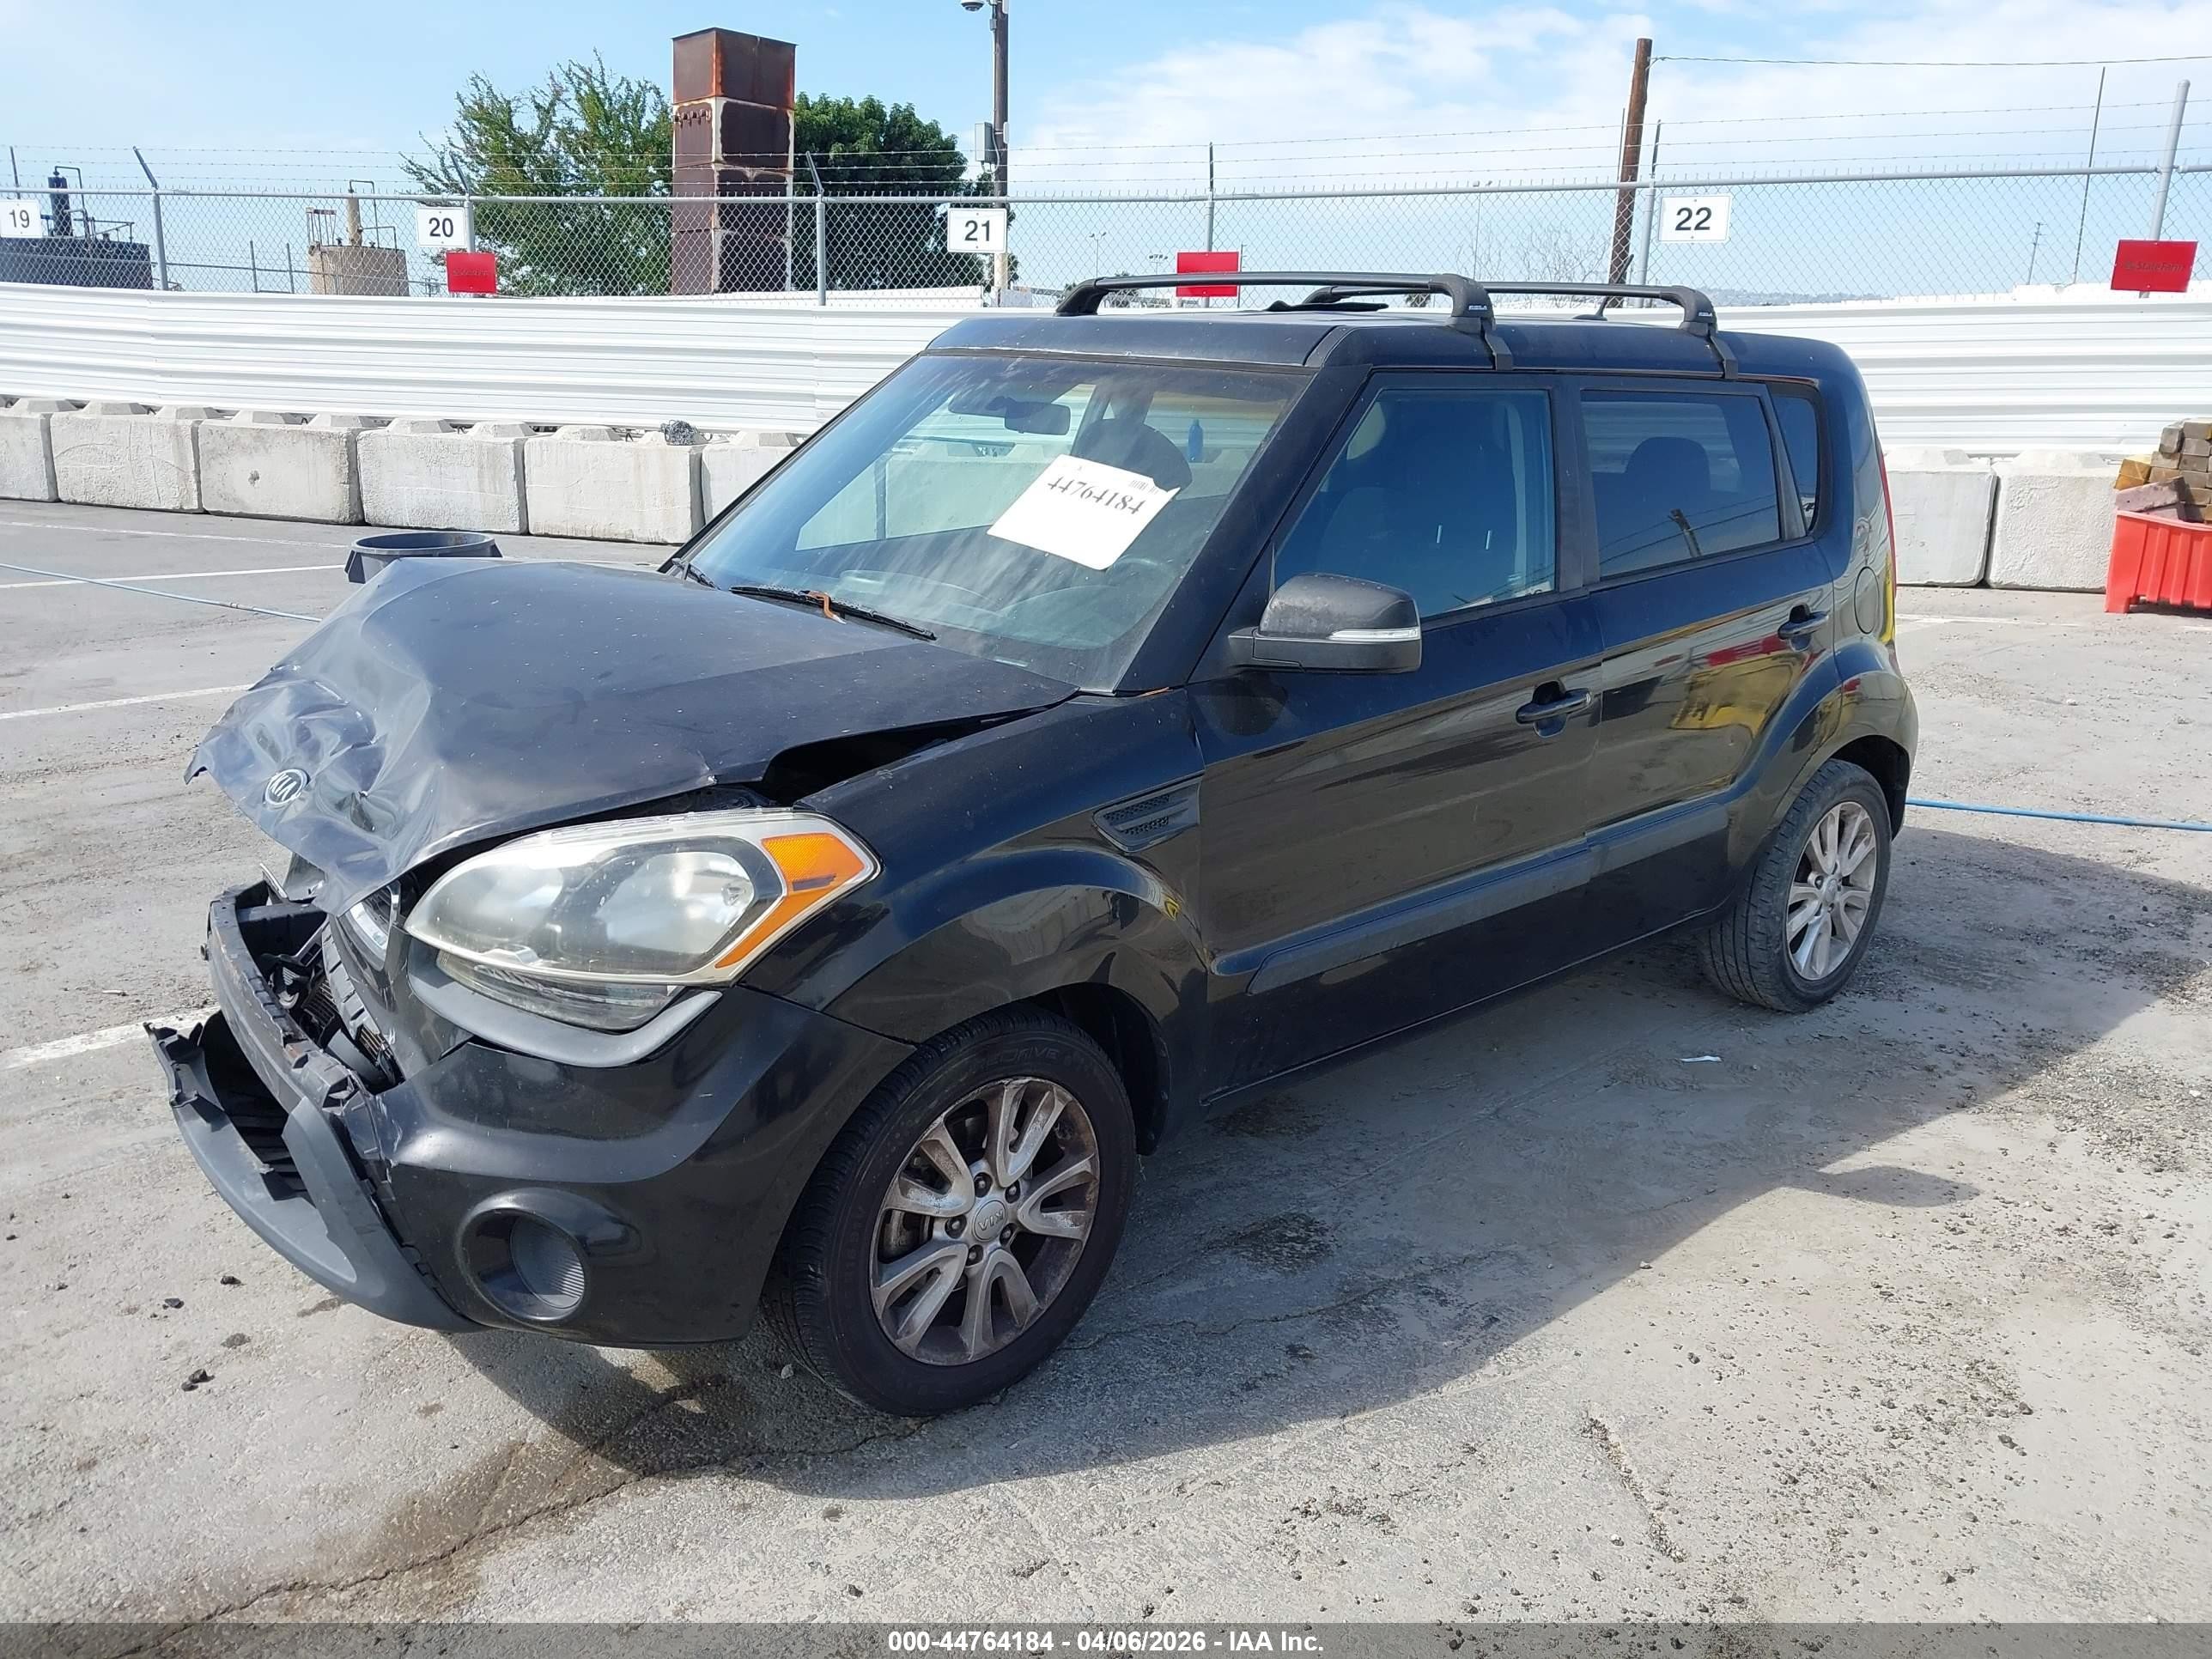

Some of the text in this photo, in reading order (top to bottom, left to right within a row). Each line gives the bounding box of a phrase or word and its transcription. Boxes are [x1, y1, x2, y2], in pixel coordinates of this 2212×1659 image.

[9, 210, 30, 228] 19
[428, 217, 454, 238] 20
[1674, 207, 1711, 231] 22
[964, 220, 990, 242] 21
[1048, 476, 1146, 514] 44764184
[978, 1208, 1004, 1231] KIA
